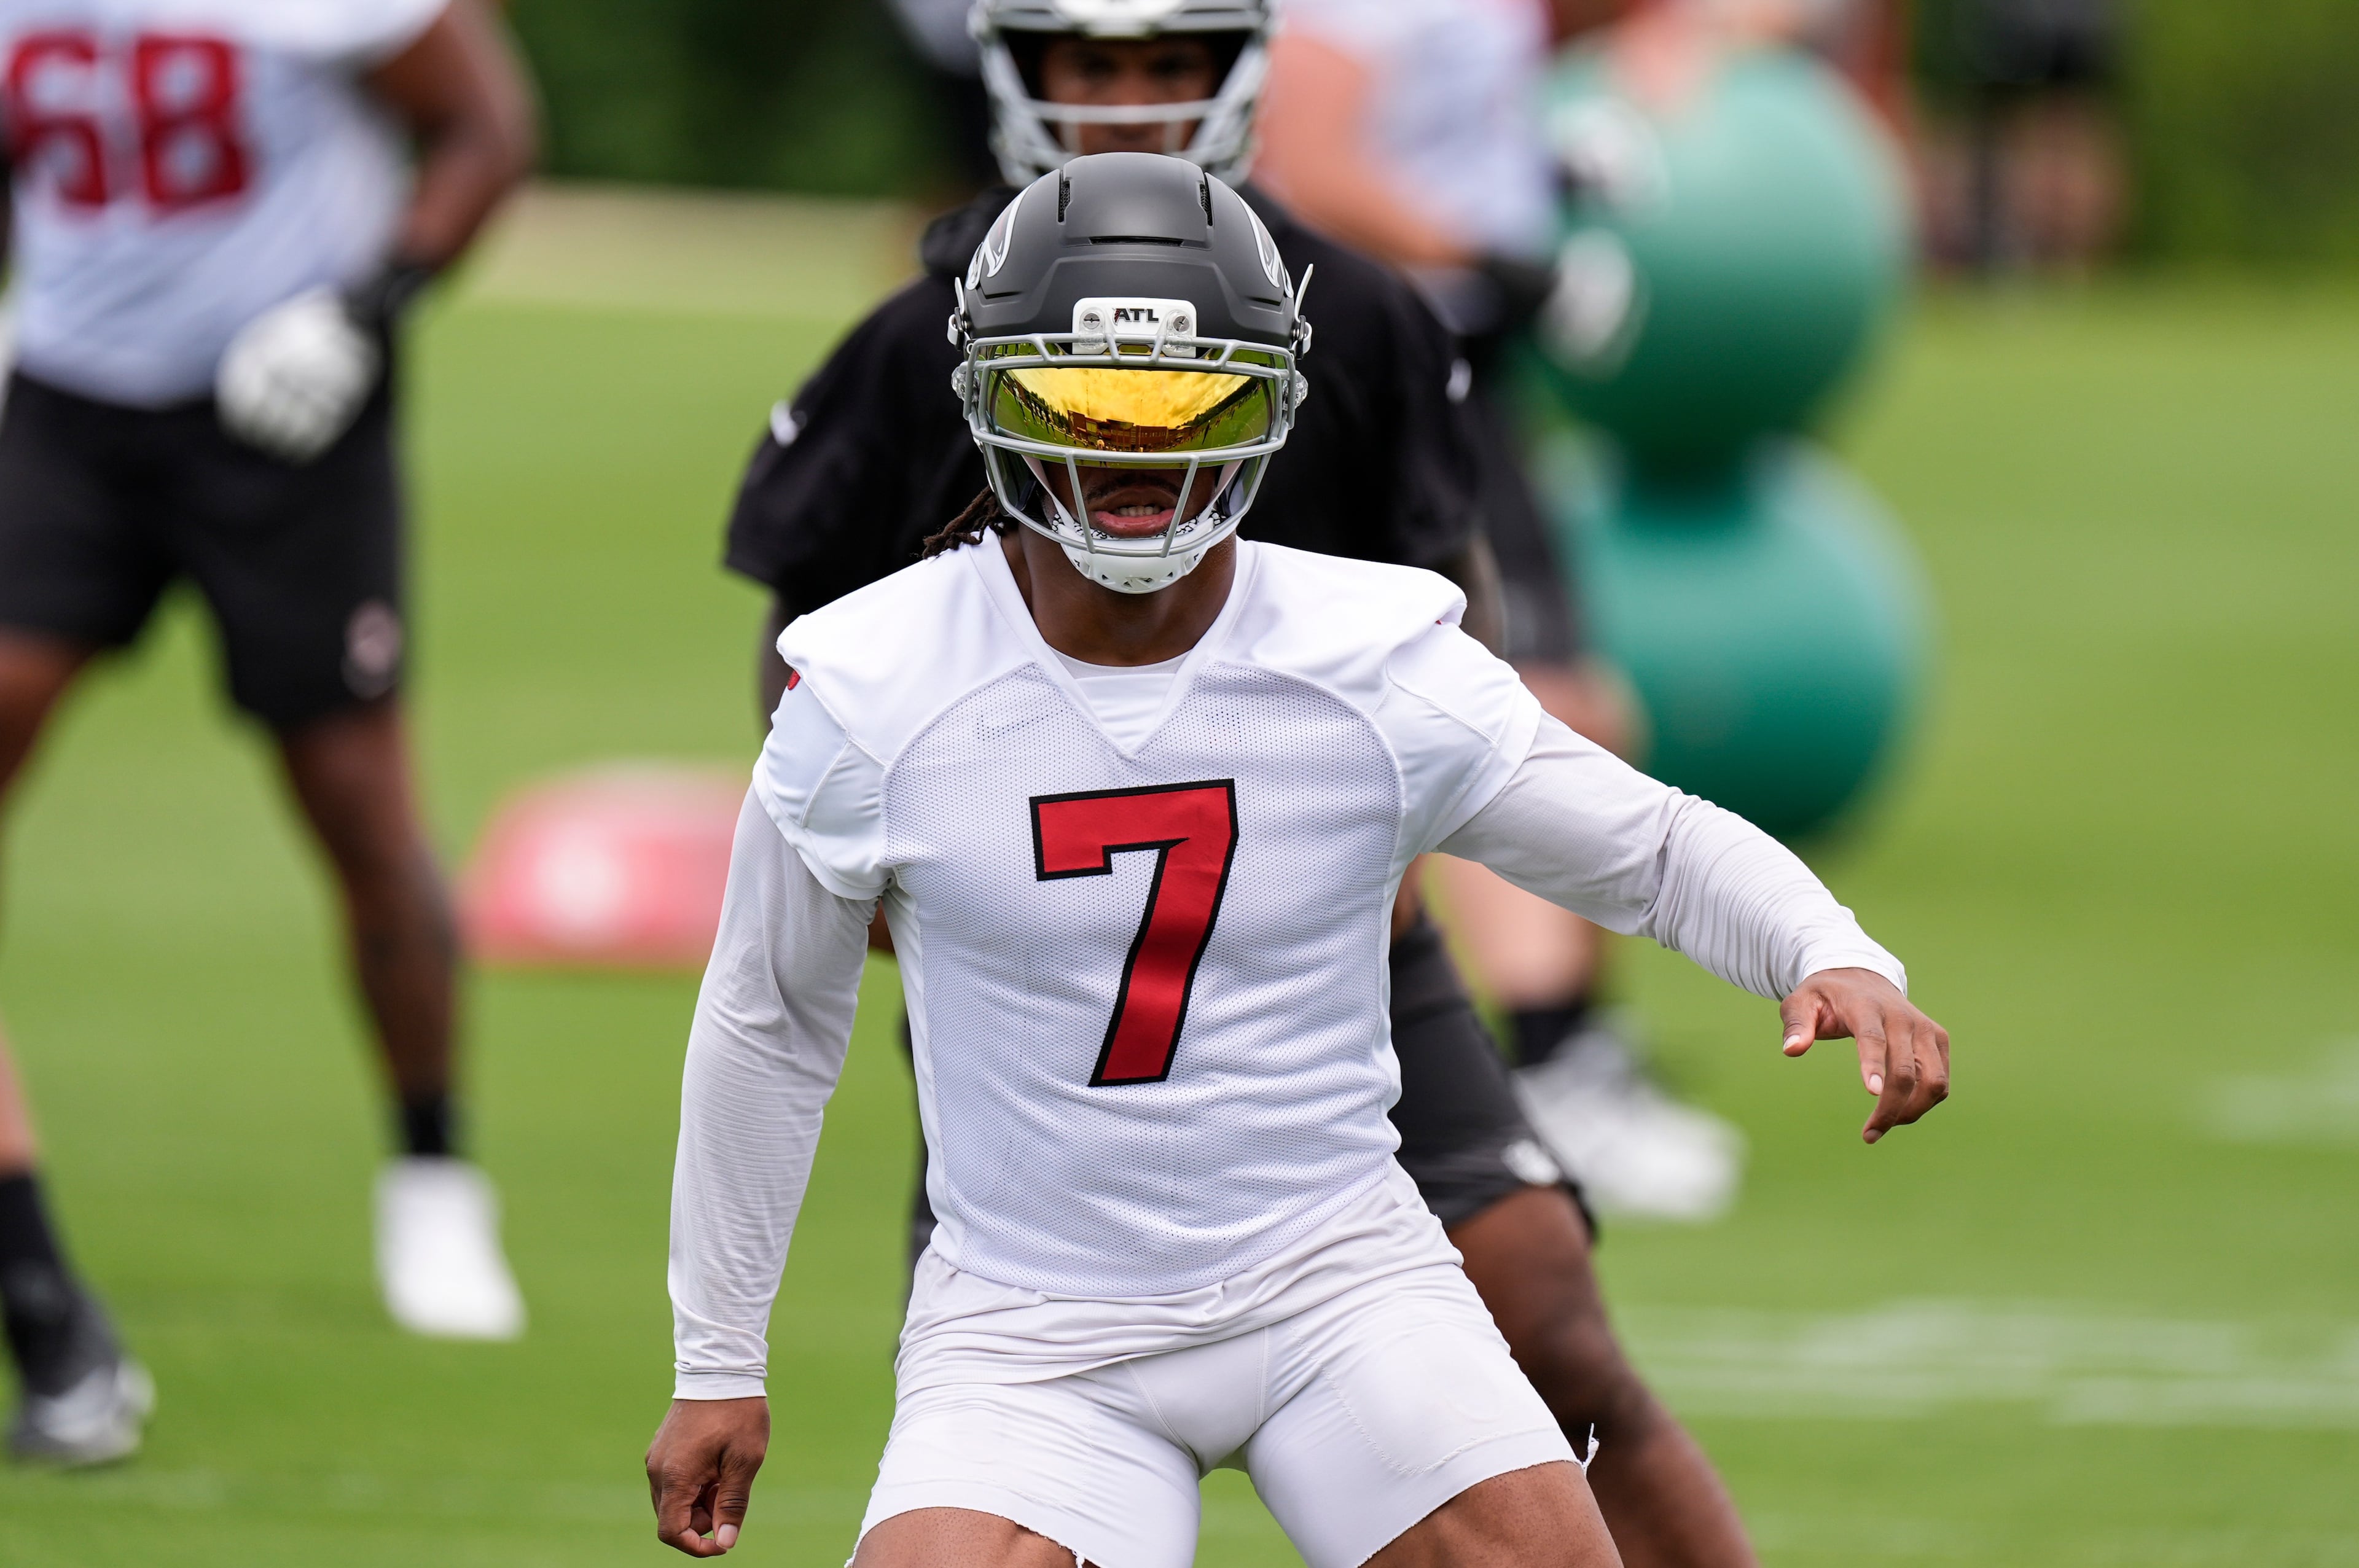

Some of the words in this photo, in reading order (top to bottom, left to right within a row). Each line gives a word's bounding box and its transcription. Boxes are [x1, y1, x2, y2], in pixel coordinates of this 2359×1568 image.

[5, 28, 251, 214] 68
[1113, 308, 1160, 326] ATL
[1029, 778, 1239, 1086] 7
